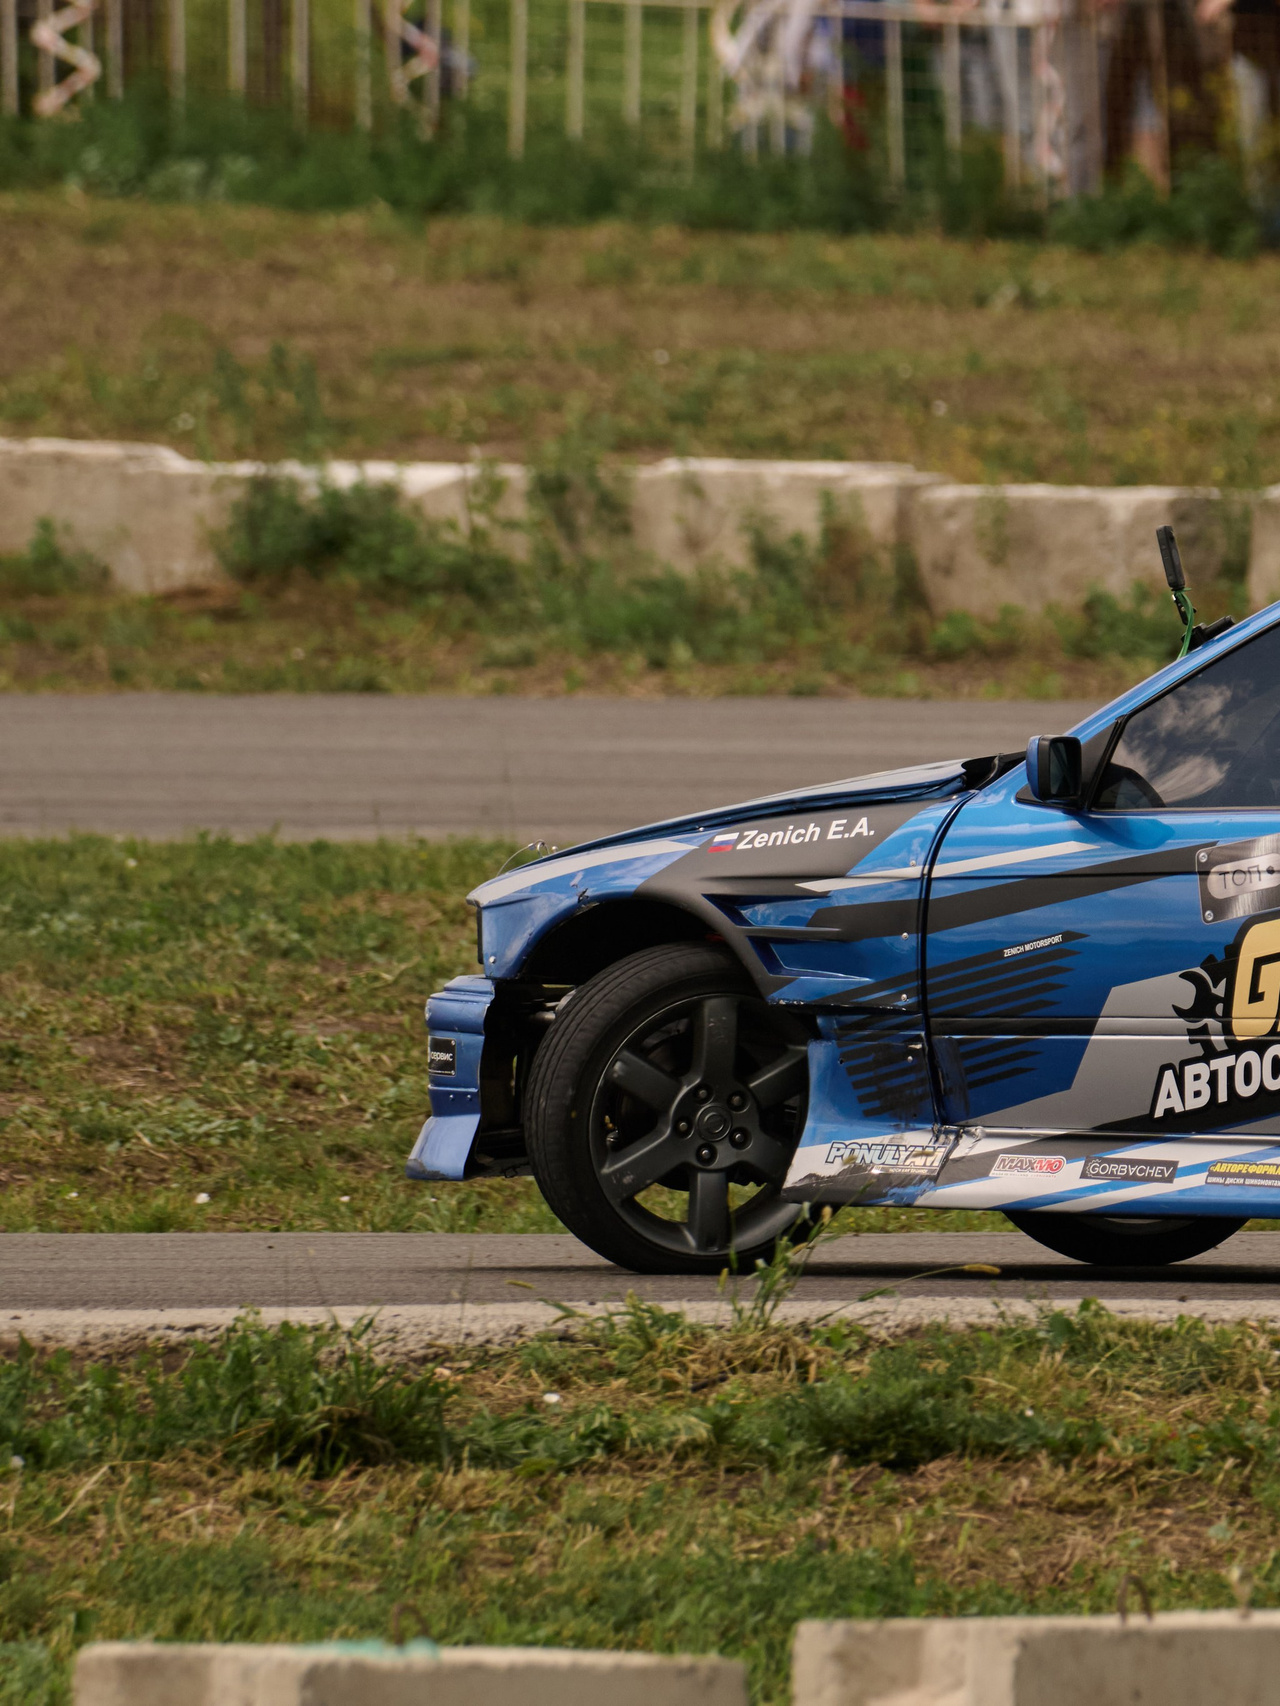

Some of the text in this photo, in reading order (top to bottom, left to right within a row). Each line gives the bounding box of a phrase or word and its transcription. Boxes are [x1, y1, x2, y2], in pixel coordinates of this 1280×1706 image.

[736, 816, 875, 850] Zenich E.A.
[1218, 864, 1262, 889] ТОП
[1003, 934, 1063, 957] ZENICH MOTORSPORT
